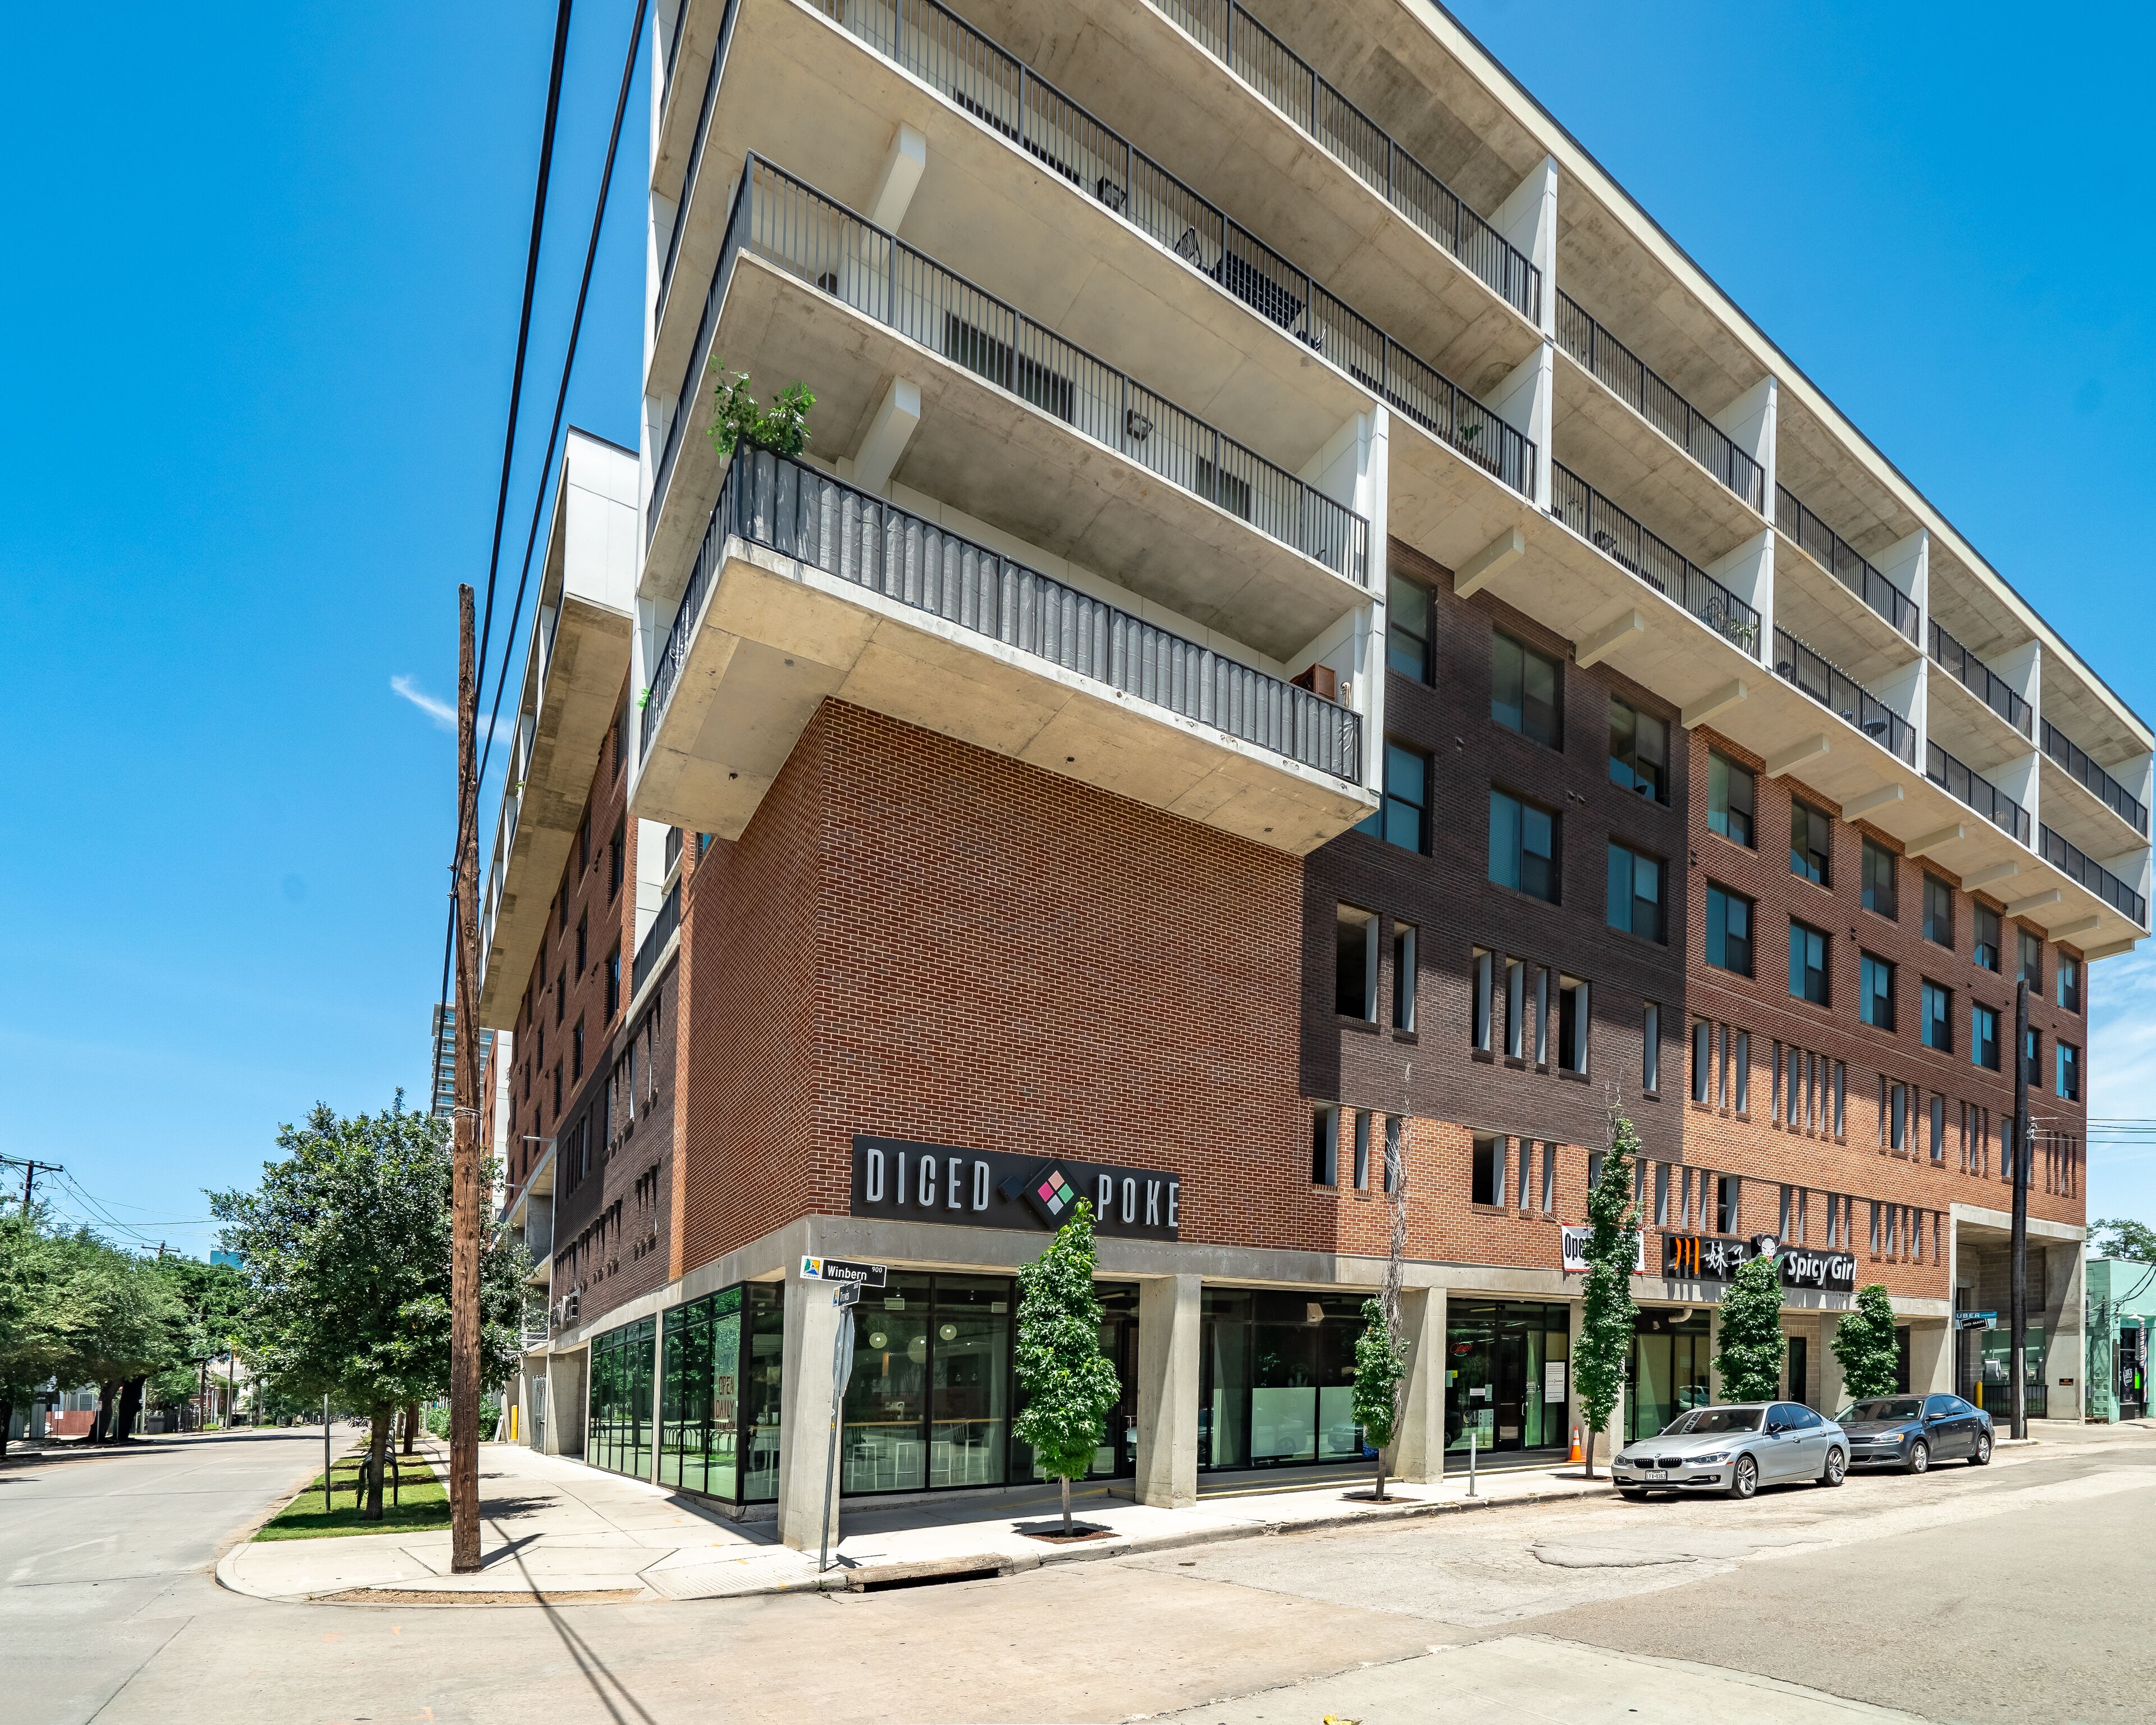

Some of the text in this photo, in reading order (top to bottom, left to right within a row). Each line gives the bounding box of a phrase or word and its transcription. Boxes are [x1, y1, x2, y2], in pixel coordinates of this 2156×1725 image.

[865, 1148, 1180, 1228] DICED POKE
[828, 1265, 867, 1280] Winbern
[1788, 1251, 1858, 1285] Spicy Girl
[839, 1290, 849, 1302] Travis
[1450, 1343, 1473, 1354] Open
[719, 1376, 734, 1395] OPEN
[716, 1400, 734, 1418] DAILY
